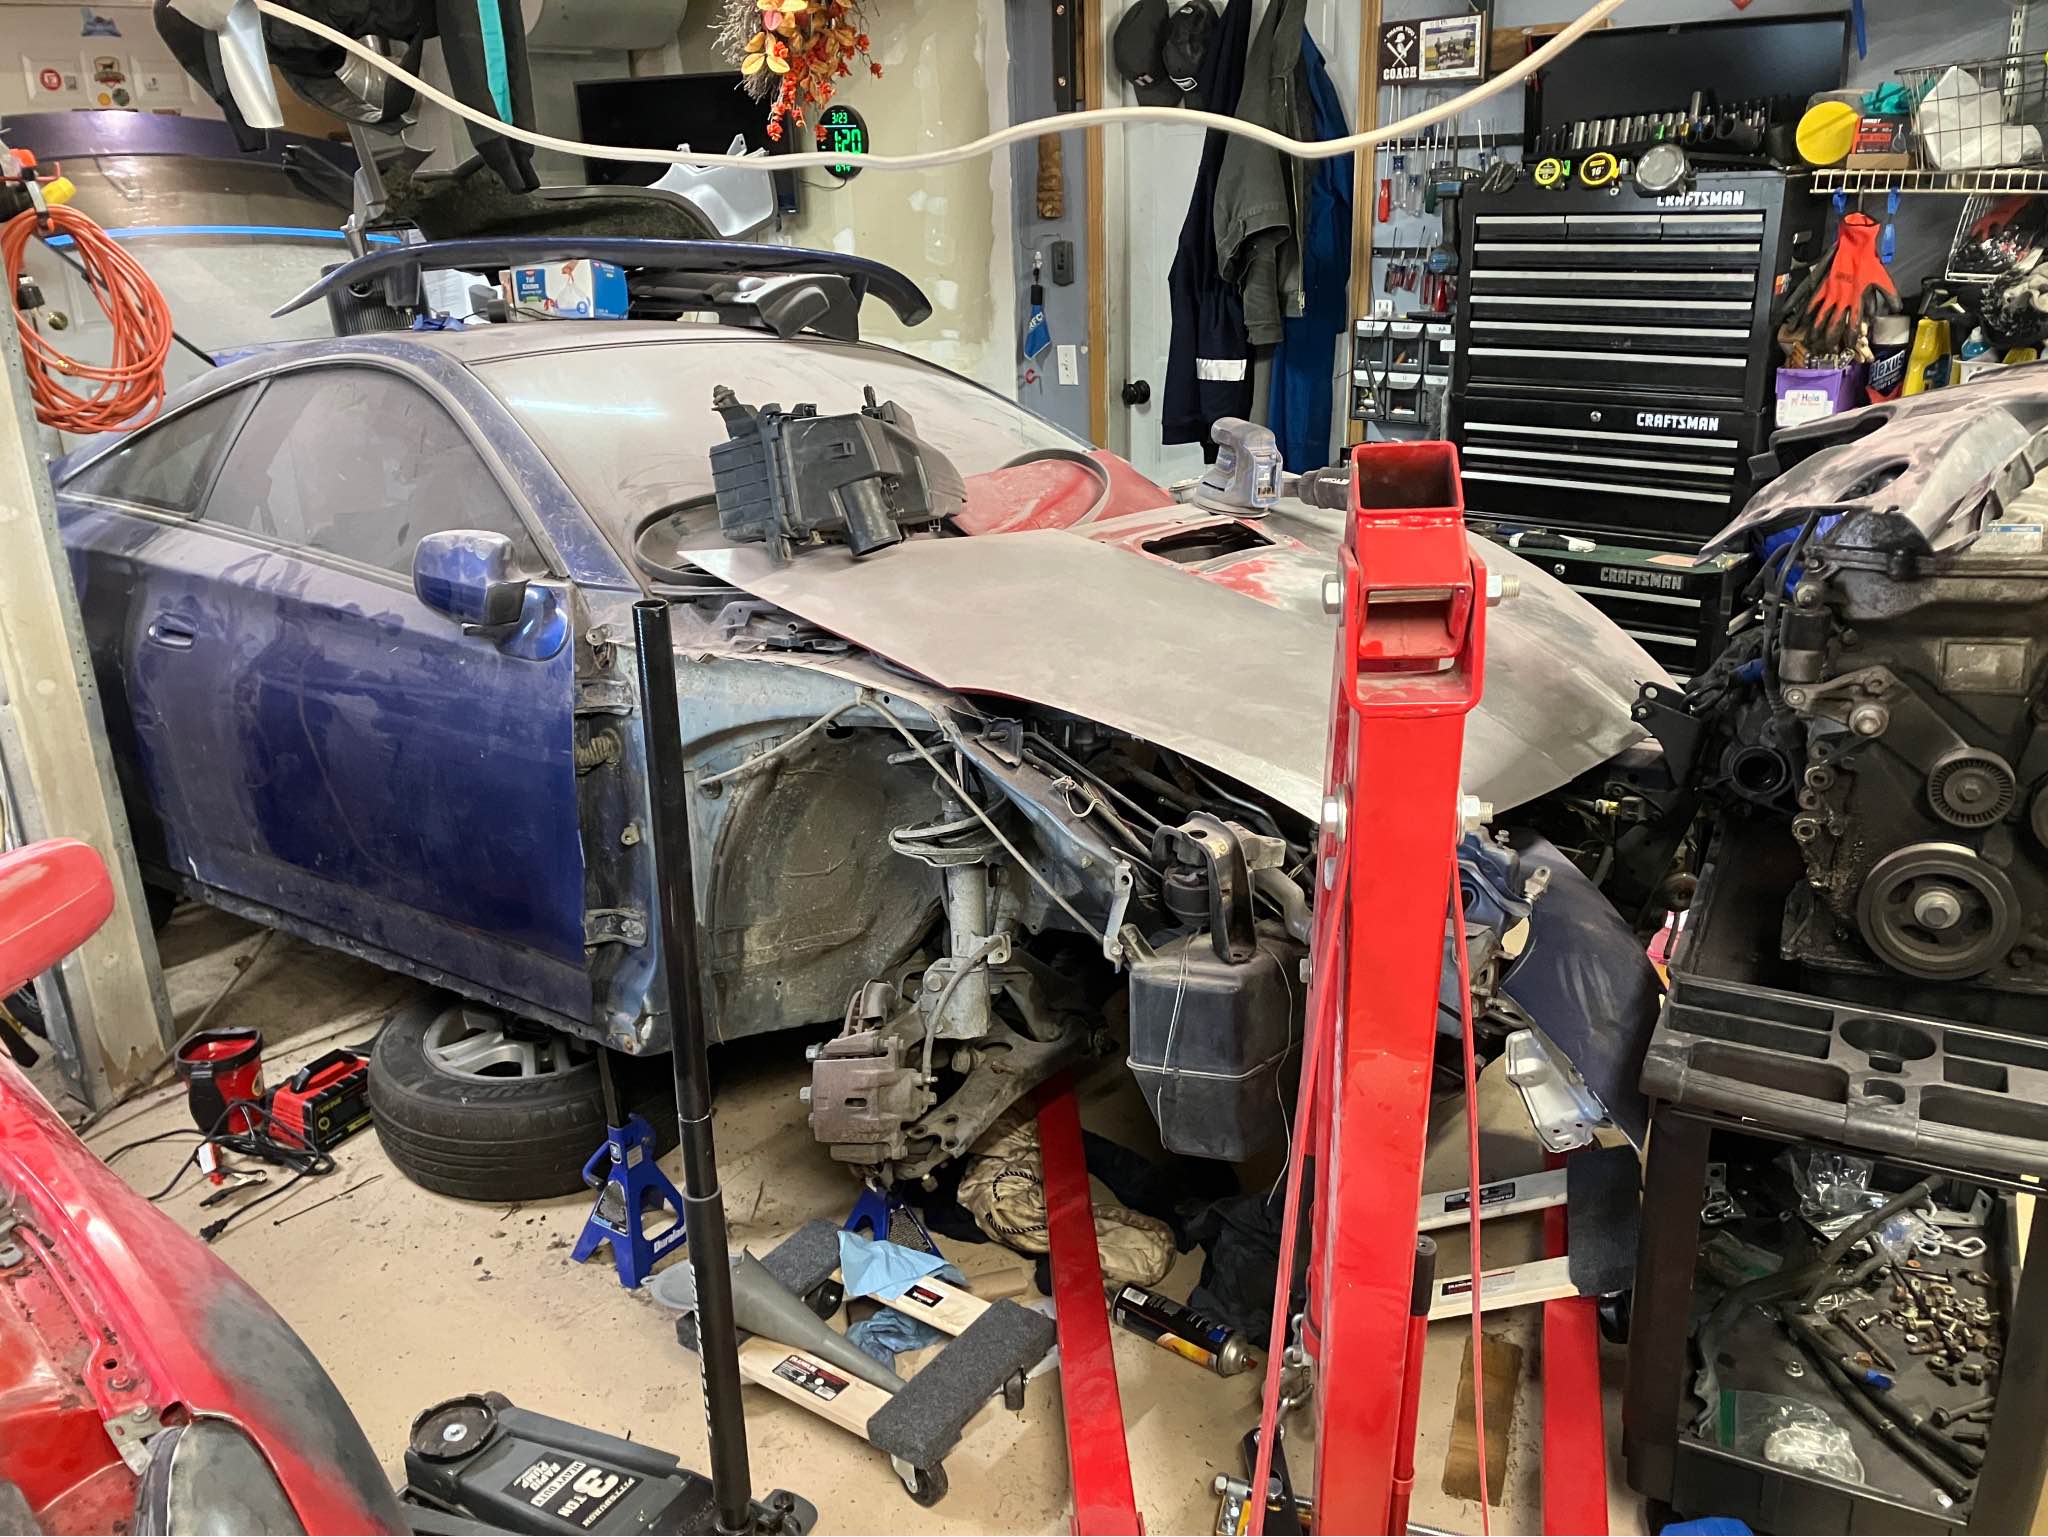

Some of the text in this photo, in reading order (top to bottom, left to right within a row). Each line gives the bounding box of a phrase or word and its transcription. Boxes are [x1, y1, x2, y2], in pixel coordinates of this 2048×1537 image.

[1383, 66, 1418, 80] COACH
[834, 129, 862, 154] 1:20
[1656, 191, 1744, 207] CRAFTSMAN
[1636, 412, 1719, 431] CRAFTSMAN
[1600, 567, 1684, 591] CRAFTSMAN
[521, 1460, 550, 1489] PUMP
[529, 1461, 561, 1491] RAPID
[559, 1462, 583, 1486] HEAVY
[536, 1485, 558, 1506] DUTY
[557, 1467, 619, 1518] 3 TON
[581, 1477, 636, 1528] PITTSBURGH
